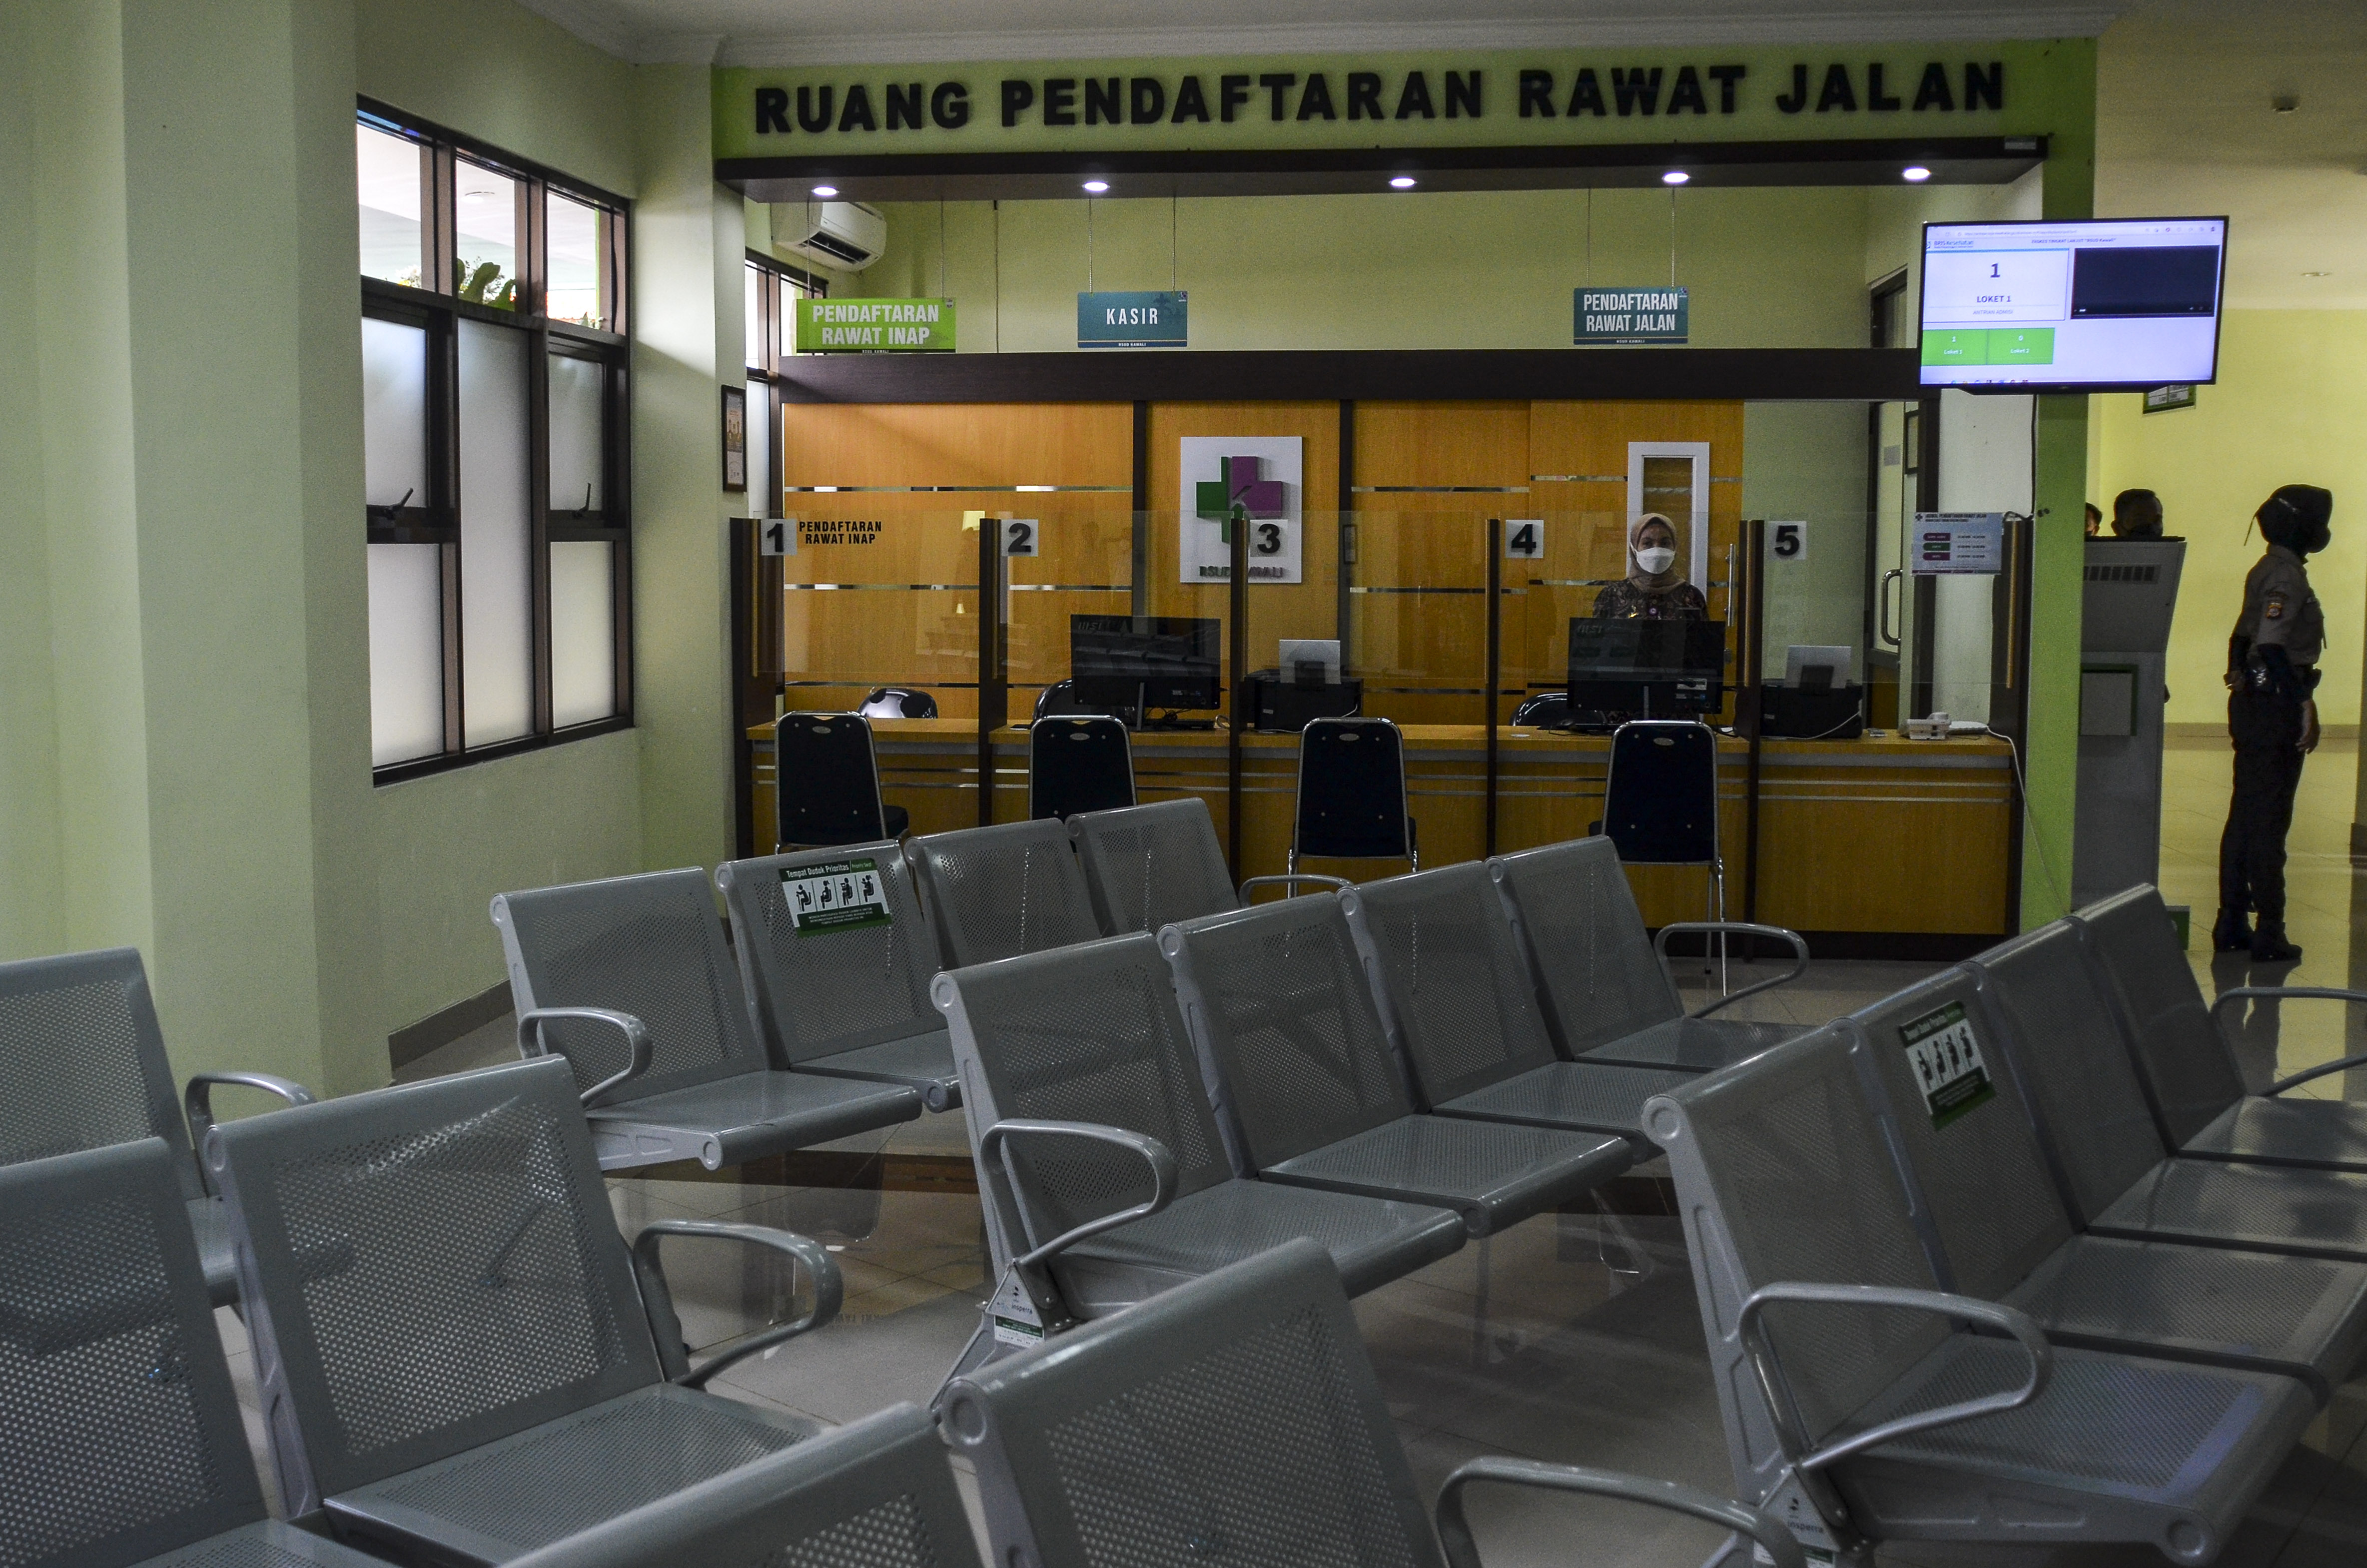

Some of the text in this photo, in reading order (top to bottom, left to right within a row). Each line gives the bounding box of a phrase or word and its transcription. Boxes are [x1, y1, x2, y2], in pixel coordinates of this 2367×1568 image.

[756, 59, 2003, 134] RUANG PENDAFTARAN RAWAT JALAN
[1991, 263, 2000, 278] 1
[1584, 293, 1678, 311] PENDAFTARAN
[812, 305, 939, 322] PENDAFTARAN
[1106, 308, 1158, 325] KASIR
[1586, 314, 1675, 332] RAWAT JALAN
[822, 327, 930, 345] RAWAT INAP
[799, 521, 881, 532] PENDAFTARAN
[767, 523, 784, 553] 1
[805, 533, 875, 544] RAWAT INAP
[1008, 523, 1031, 553] 2
[1257, 524, 1281, 553] 3
[1511, 524, 1537, 554] 4
[1774, 525, 1800, 556] 5
[1248, 566, 1284, 578] AWALI
[786, 870, 807, 878] Tempat
[825, 864, 849, 873] Prioritas
